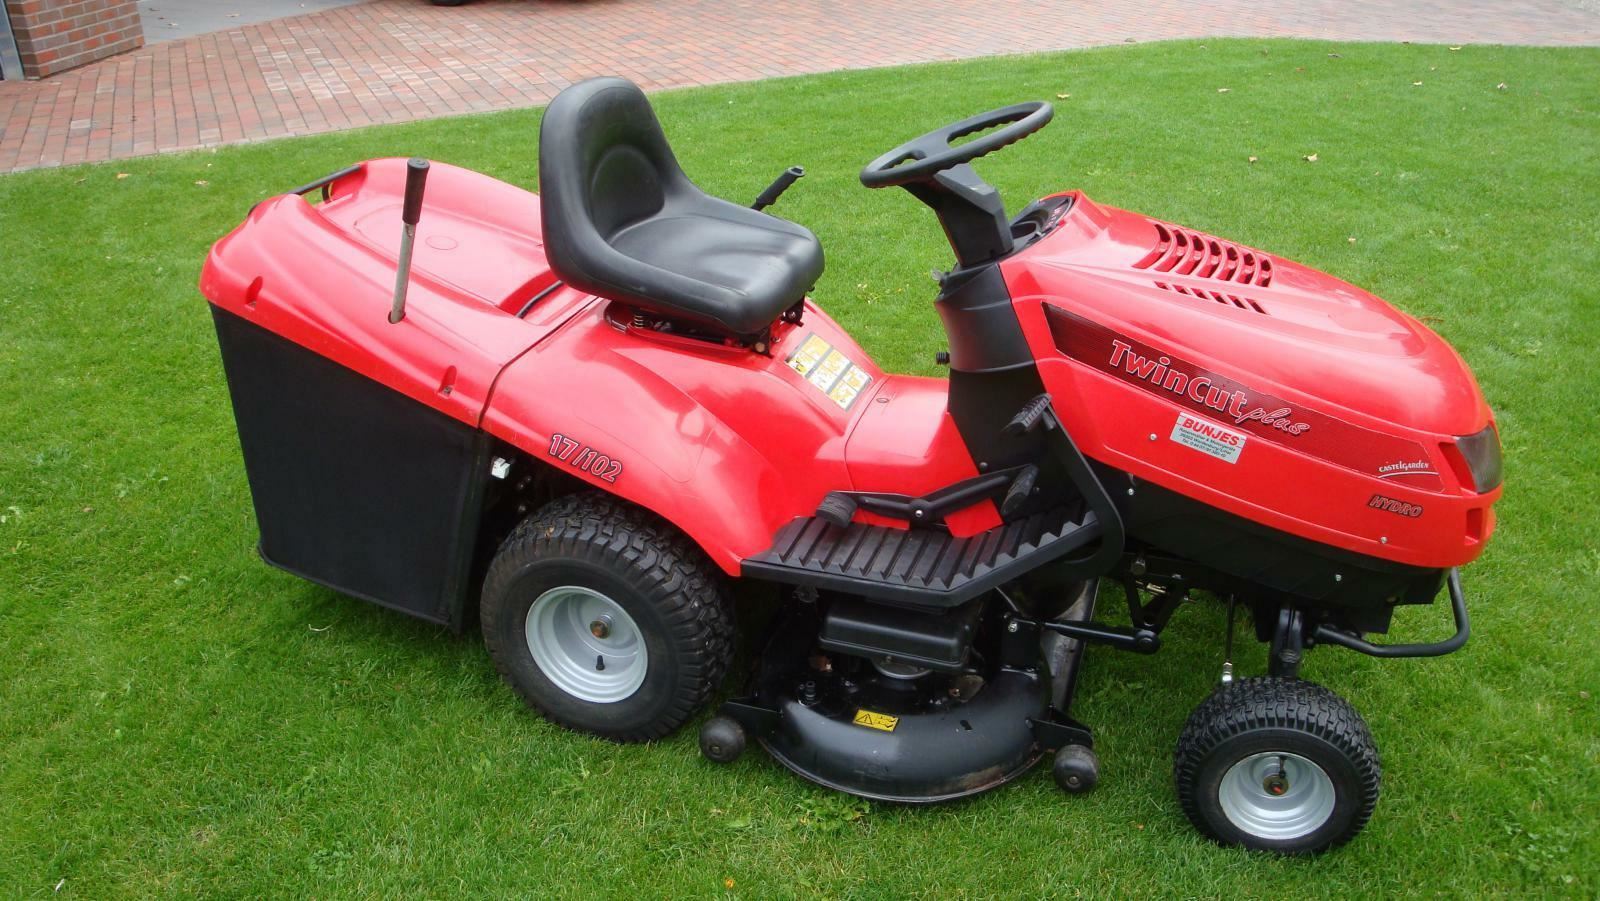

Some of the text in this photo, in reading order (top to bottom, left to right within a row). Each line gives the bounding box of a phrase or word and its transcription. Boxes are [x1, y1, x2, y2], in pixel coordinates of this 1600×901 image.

[1109, 339, 1311, 436] TwinCut plus
[1182, 417, 1240, 446] BUNJES
[549, 433, 622, 483] 17/102
[1368, 494, 1423, 517] HYDRO
